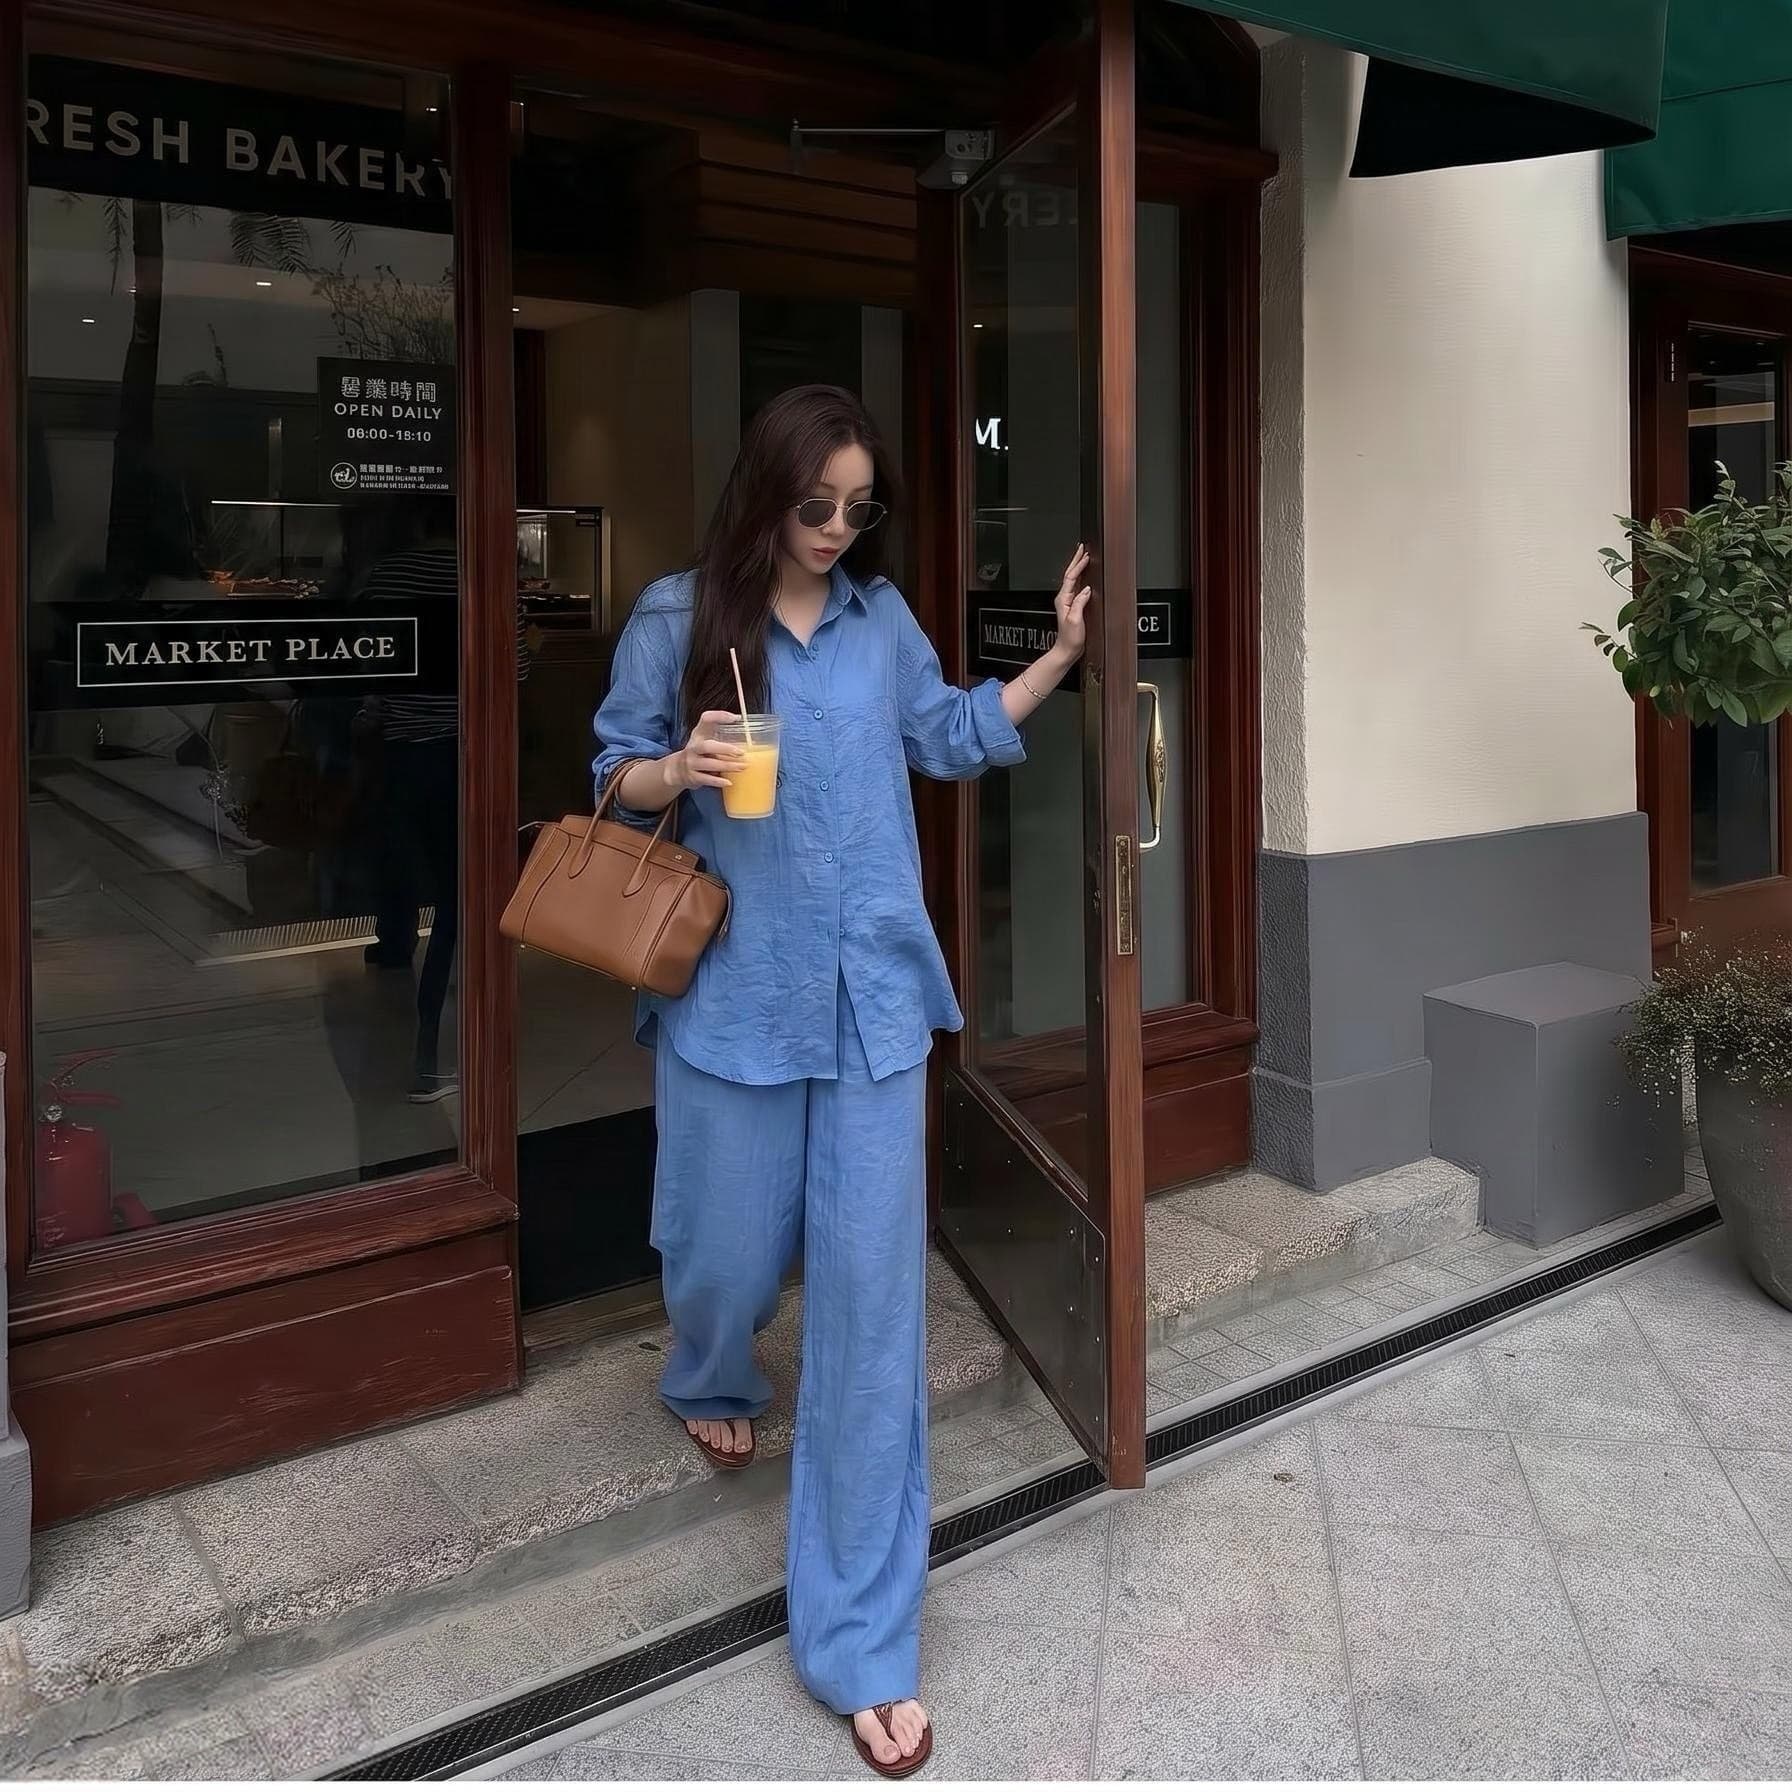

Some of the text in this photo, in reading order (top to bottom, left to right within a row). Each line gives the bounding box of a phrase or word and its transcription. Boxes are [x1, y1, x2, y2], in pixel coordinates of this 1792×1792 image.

[334, 402, 442, 420] OPEN DAILY
[105, 636, 396, 666] MARKET PLACE
[983, 623, 1058, 651] MARKET PLAC
